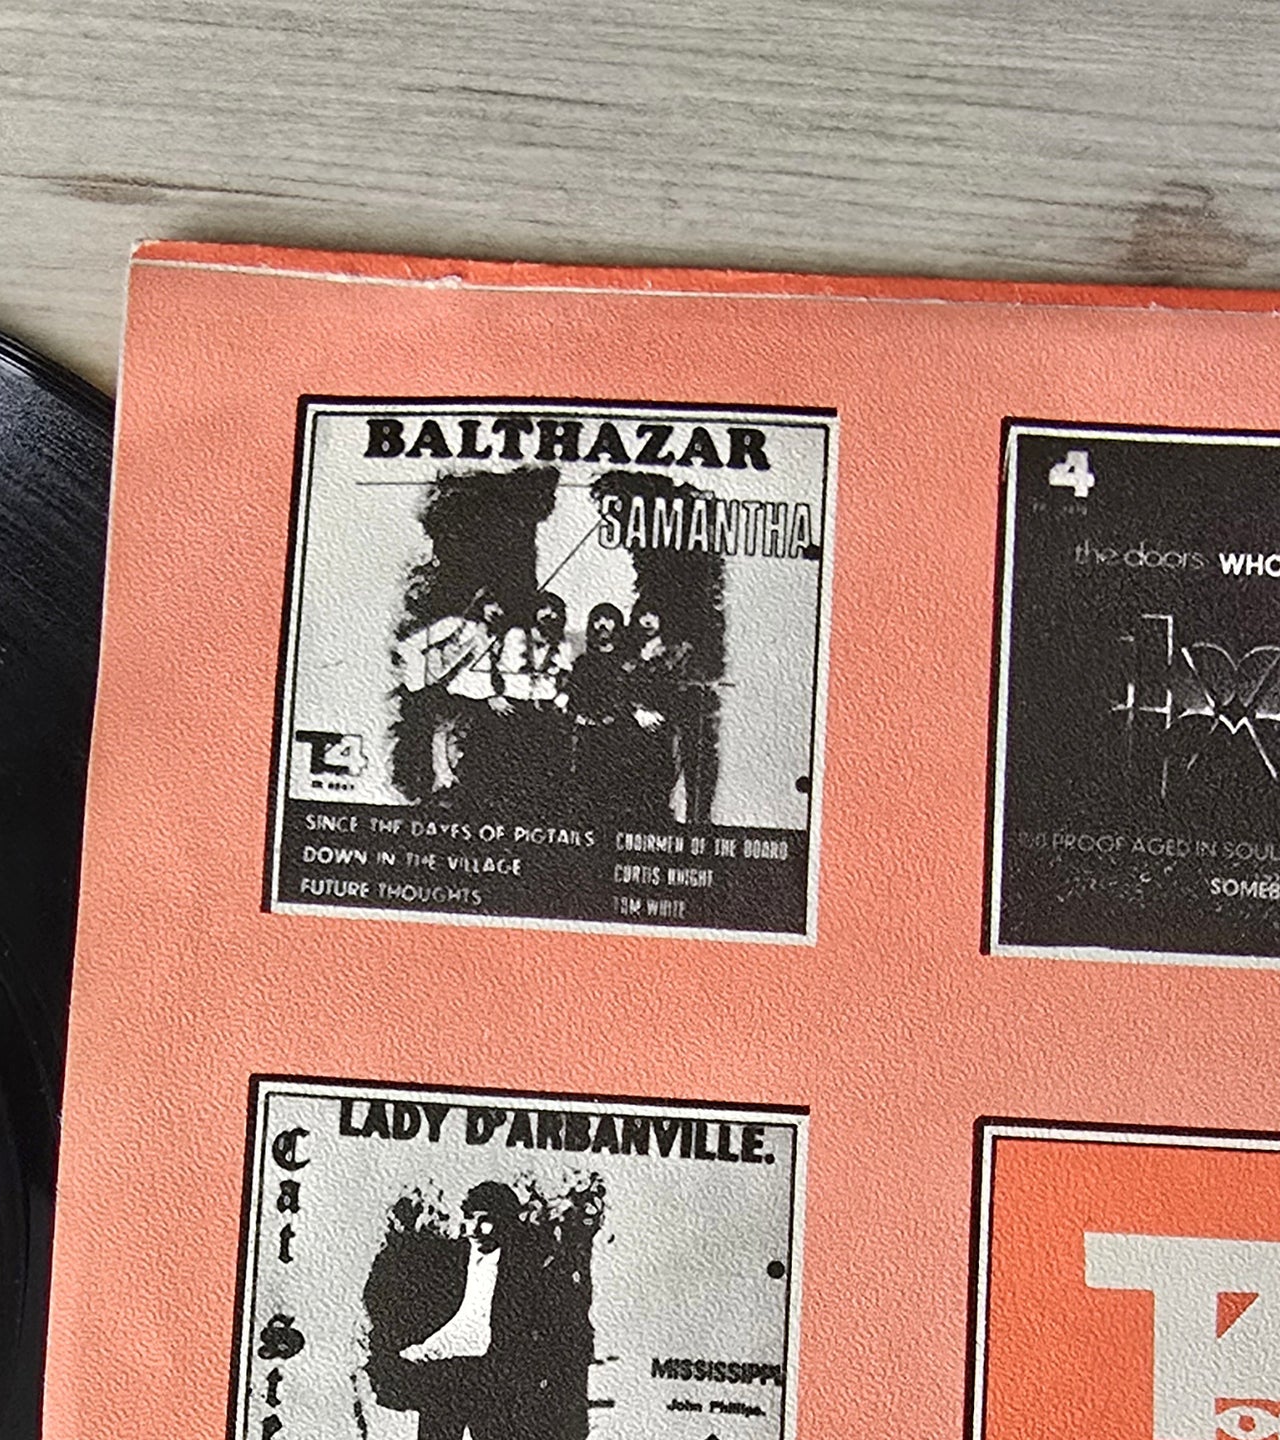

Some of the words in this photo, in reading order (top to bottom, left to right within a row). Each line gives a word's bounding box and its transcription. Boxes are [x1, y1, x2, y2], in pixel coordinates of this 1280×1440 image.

[364, 418, 771, 470] BALTHAZAR
[1049, 450, 1095, 497] 4
[598, 495, 814, 559] SAMANTHA
[1123, 541, 1204, 570] doors
[305, 814, 358, 834] SINCE
[370, 818, 402, 836] THE
[479, 824, 506, 842] OF
[514, 826, 595, 847] PIGTAILS
[302, 846, 367, 865] DOWN
[376, 851, 396, 866] IN
[447, 855, 522, 877] VILLAGE
[714, 838, 736, 858] THE
[1131, 837, 1191, 859] AGED
[1196, 840, 1219, 860] IN
[300, 878, 369, 898] FUTURE
[378, 884, 483, 905] THOUGHTS
[339, 1100, 449, 1141] LADY
